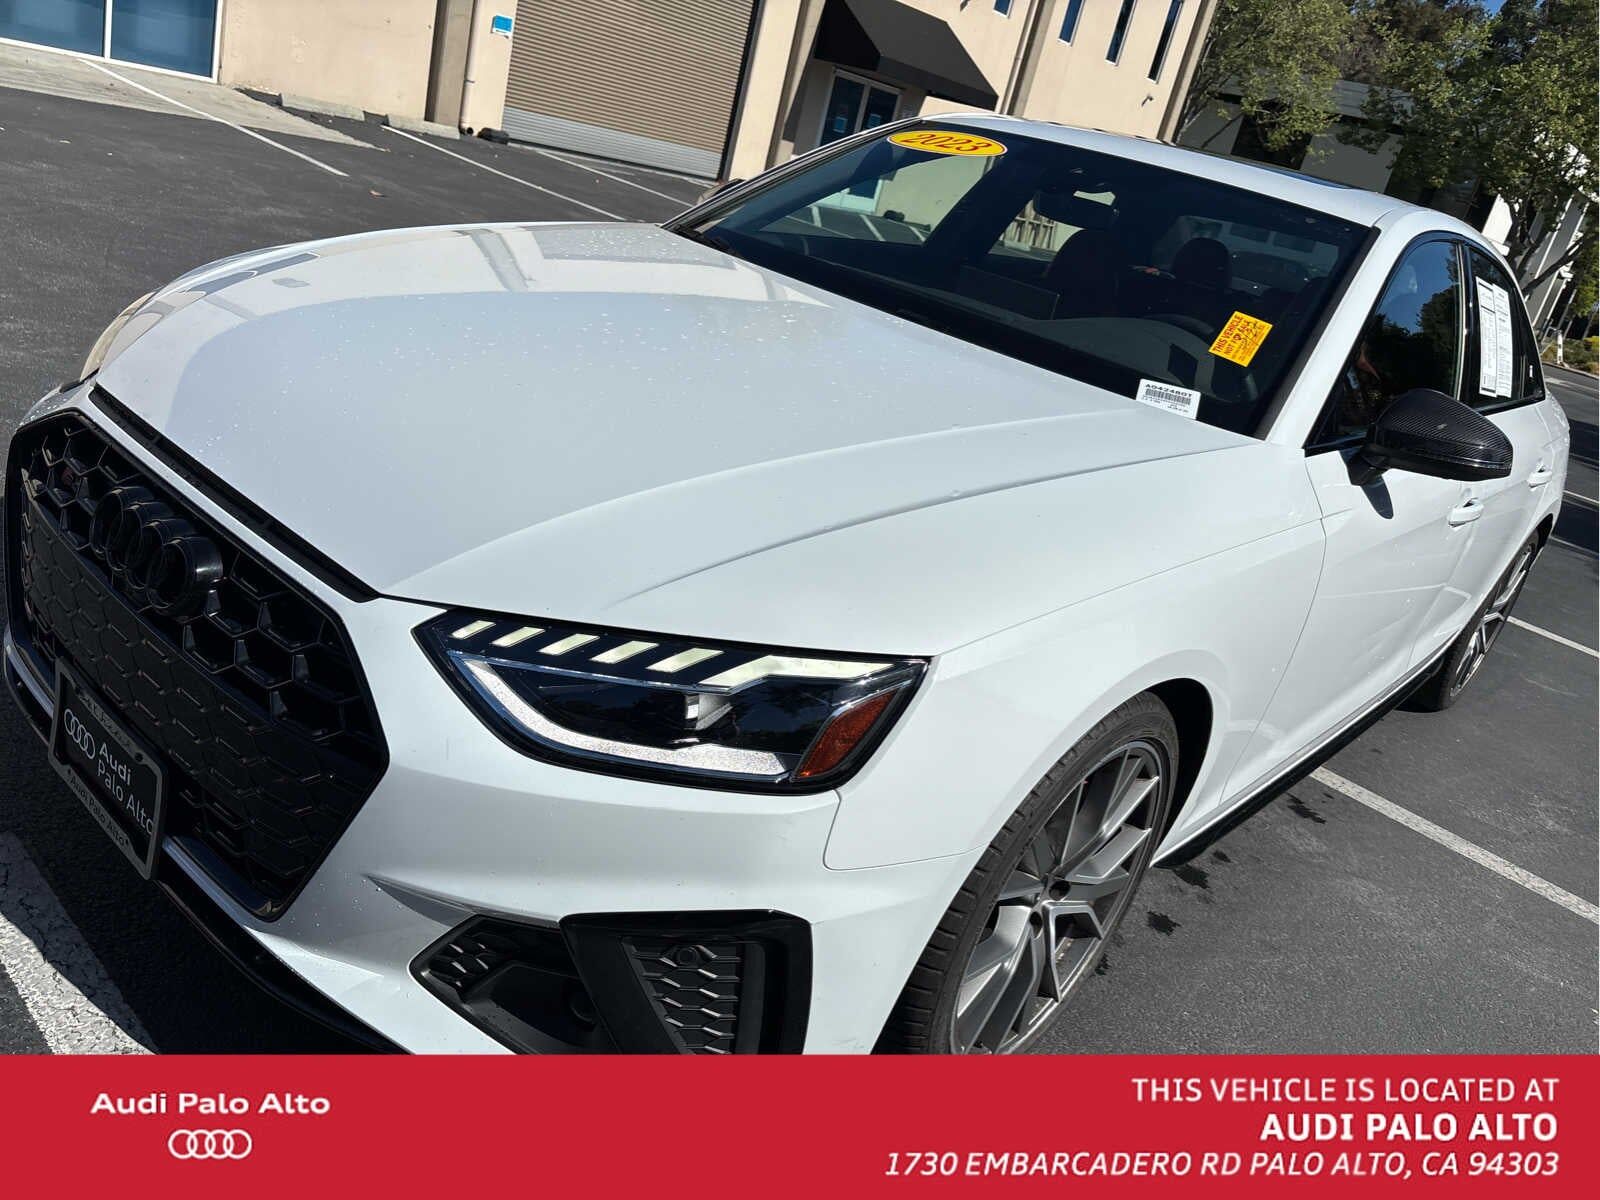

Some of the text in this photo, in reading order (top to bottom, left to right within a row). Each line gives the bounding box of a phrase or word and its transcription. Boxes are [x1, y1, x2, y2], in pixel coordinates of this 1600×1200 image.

[900, 133, 993, 152] 2023
[1211, 313, 1244, 353] THIS VEHICLE
[1223, 342, 1235, 355] NOT
[99, 741, 132, 786] Audi
[97, 758, 124, 802] Palo
[126, 793, 153, 836] Alto
